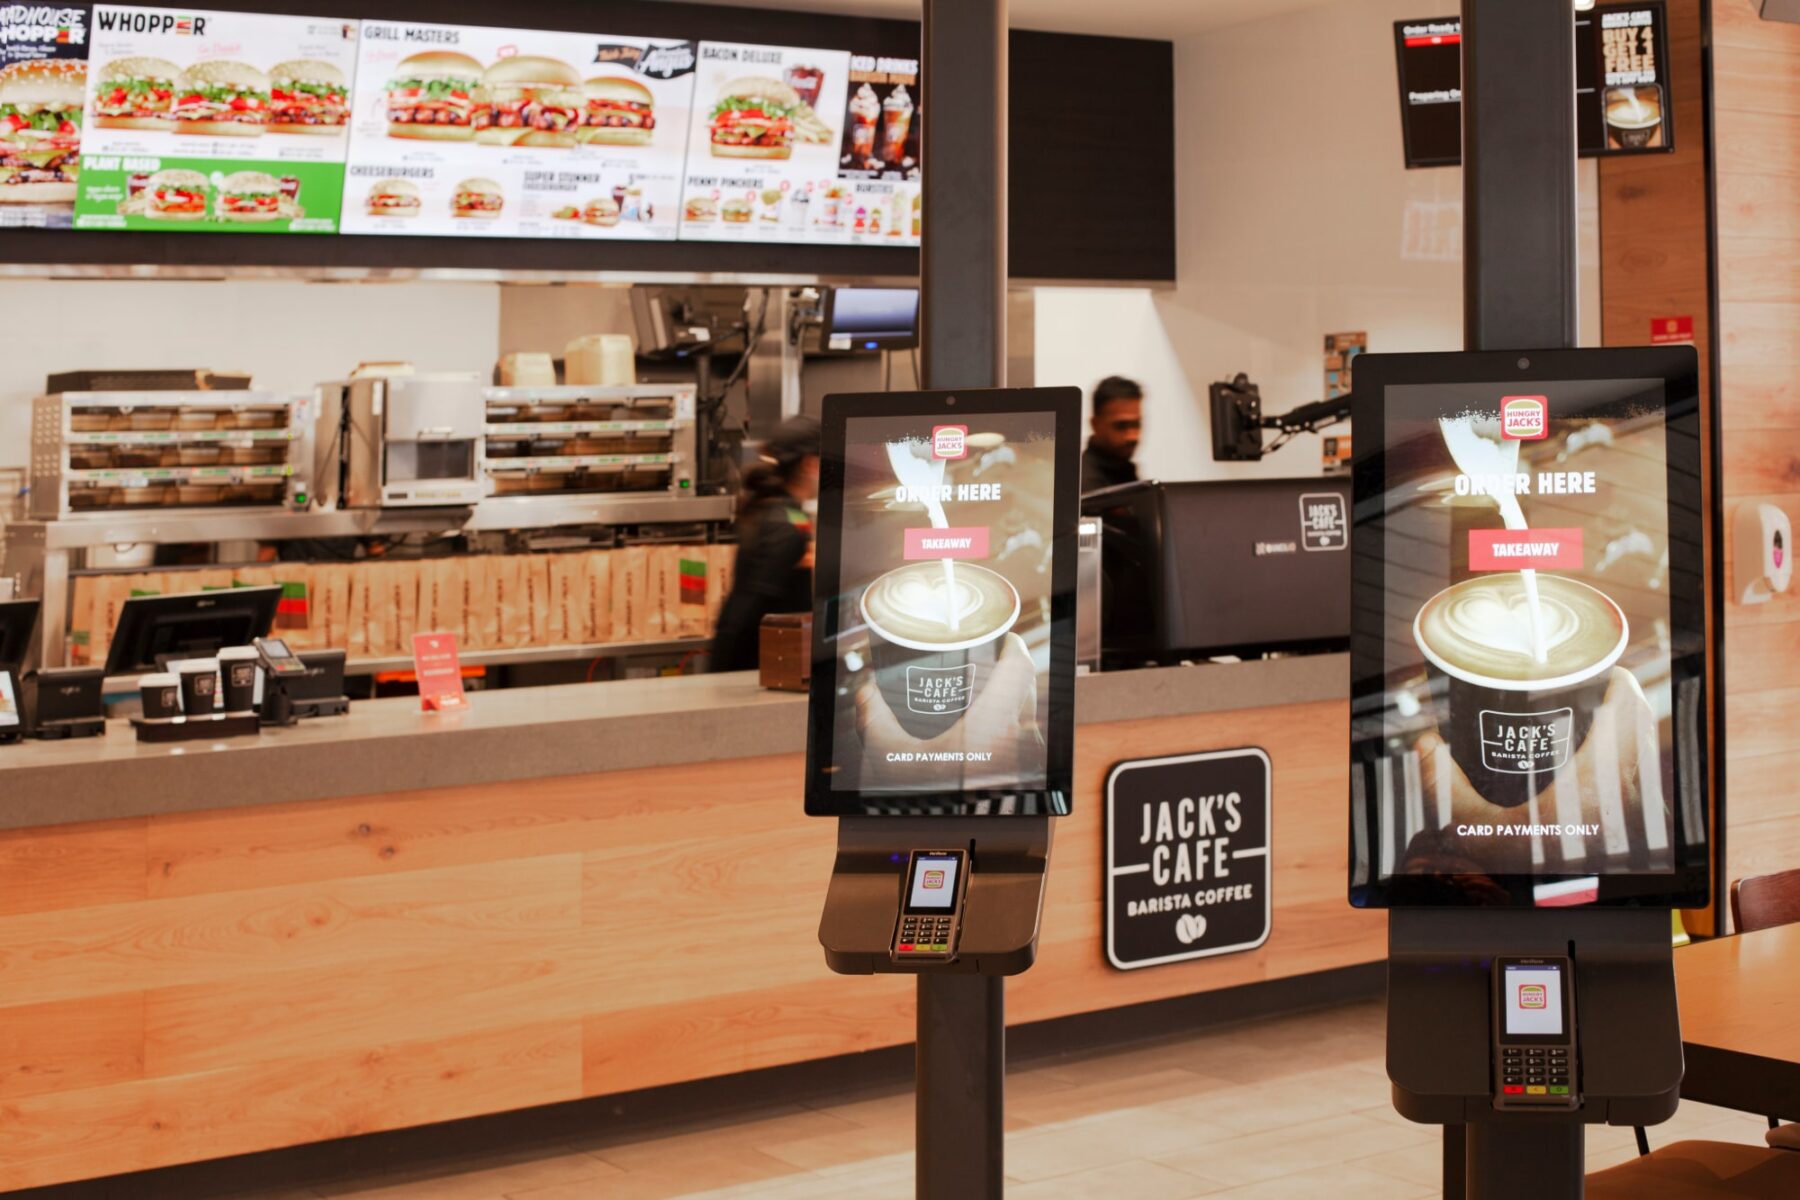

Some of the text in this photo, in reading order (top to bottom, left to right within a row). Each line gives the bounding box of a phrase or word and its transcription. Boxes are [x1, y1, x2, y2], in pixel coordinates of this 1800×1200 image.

[98, 11, 206, 35] WHOPPER
[365, 26, 460, 44] GRILL MASTERS
[1602, 28, 1638, 43] BUY
[702, 47, 782, 64] BACON DELUXE
[1603, 43, 1637, 57] GET
[1605, 55, 1655, 72] FREE
[1455, 472, 1596, 495] ORDER HERE
[895, 483, 1001, 502] ORDER HERE
[921, 538, 972, 549] TAKEAWAY
[1492, 543, 1559, 557] TAKEAWAY
[919, 676, 964, 688] JACK'S
[924, 687, 957, 698] CAFE
[1497, 724, 1556, 738] JACK'S
[1505, 738, 1549, 752] CAFE
[886, 752, 992, 762] CARD PAYMENTS ONLY
[1140, 792, 1242, 844] JACK'S
[1457, 824, 1600, 836] CARD PAYMENTS ONLY
[1153, 837, 1230, 886] CAFE
[1127, 884, 1252, 917] BARISTA COFFEE
